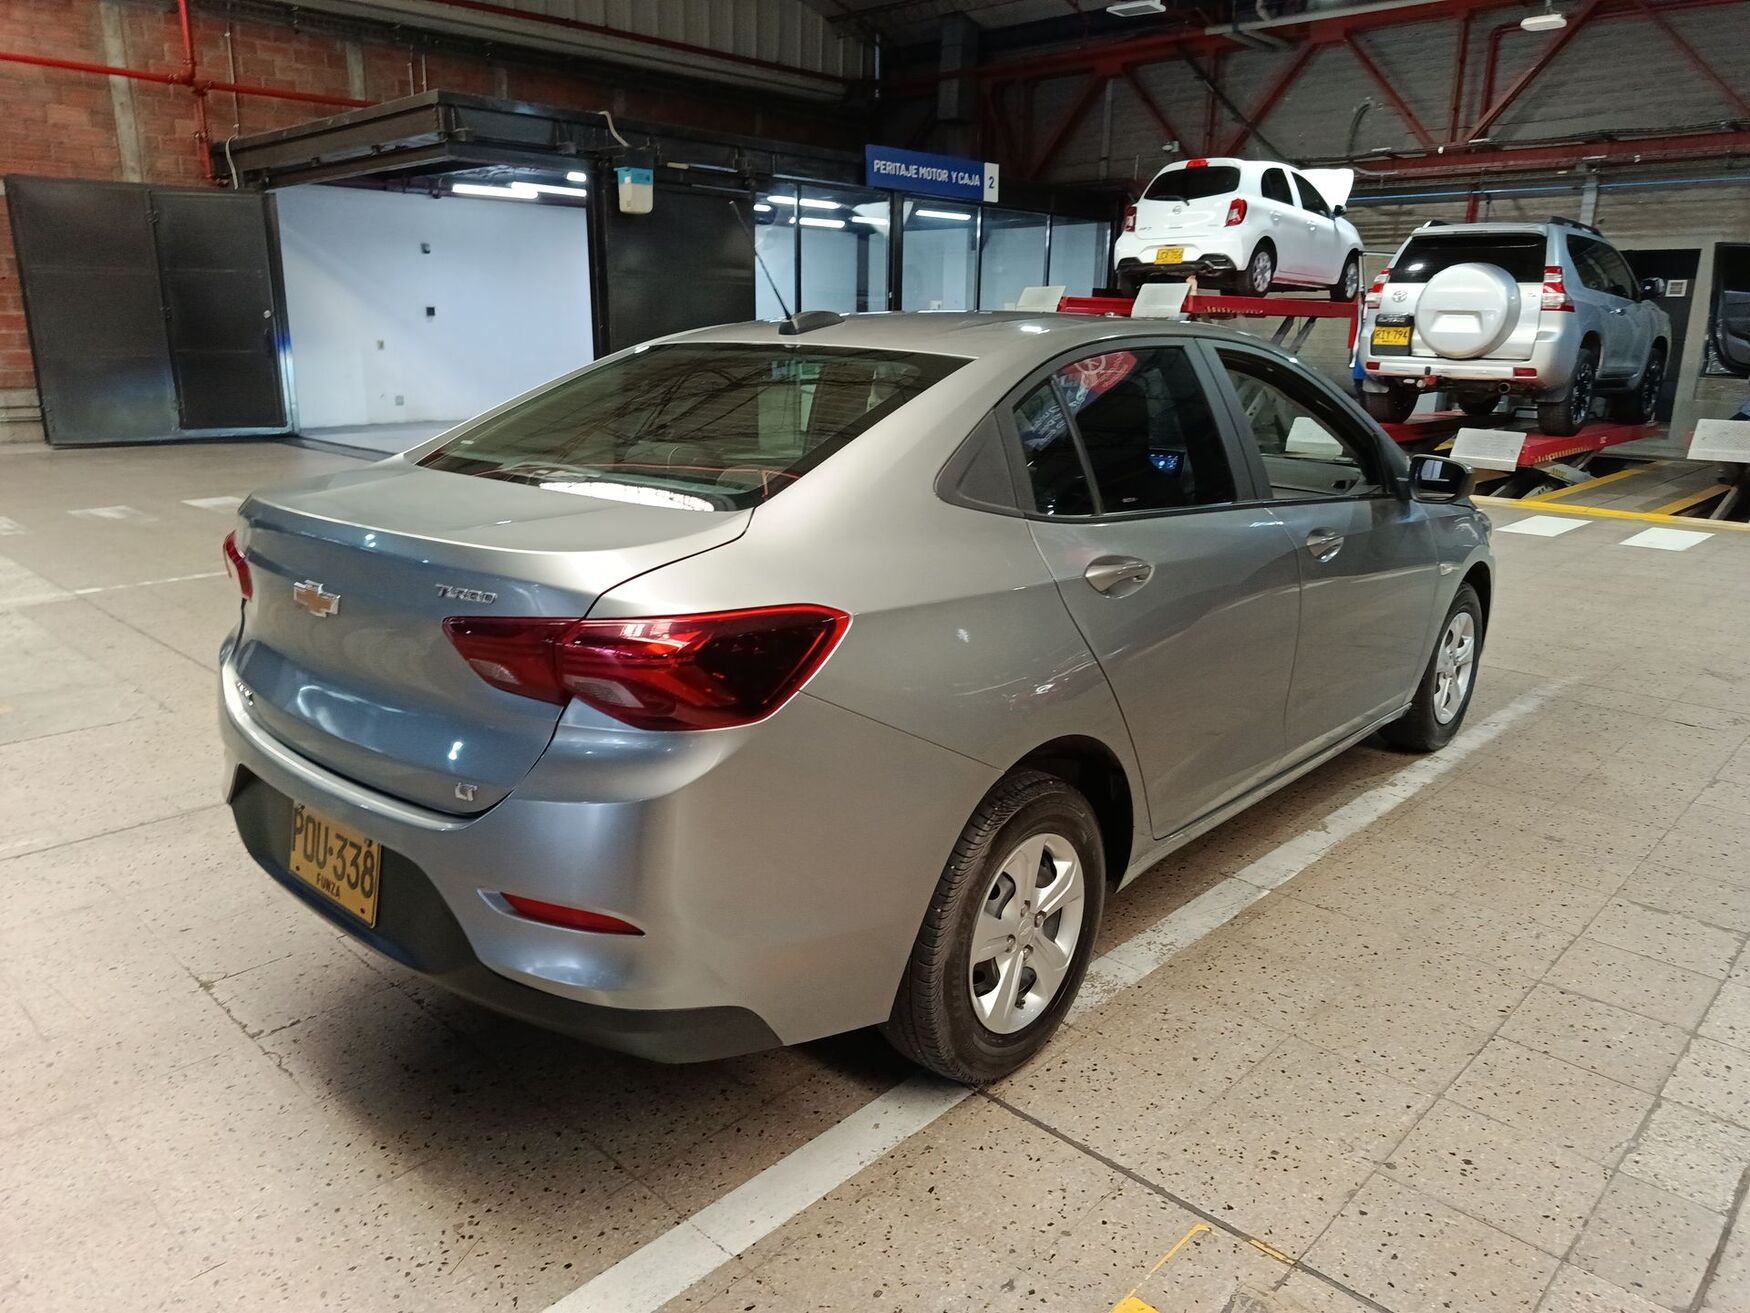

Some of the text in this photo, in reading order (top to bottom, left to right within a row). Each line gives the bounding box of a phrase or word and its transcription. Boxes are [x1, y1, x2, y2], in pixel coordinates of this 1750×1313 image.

[873, 159, 981, 187] PERITAJE MOTOR Y CAJA
[988, 176, 995, 189] 2
[316, 872, 341, 899] FUNZA
